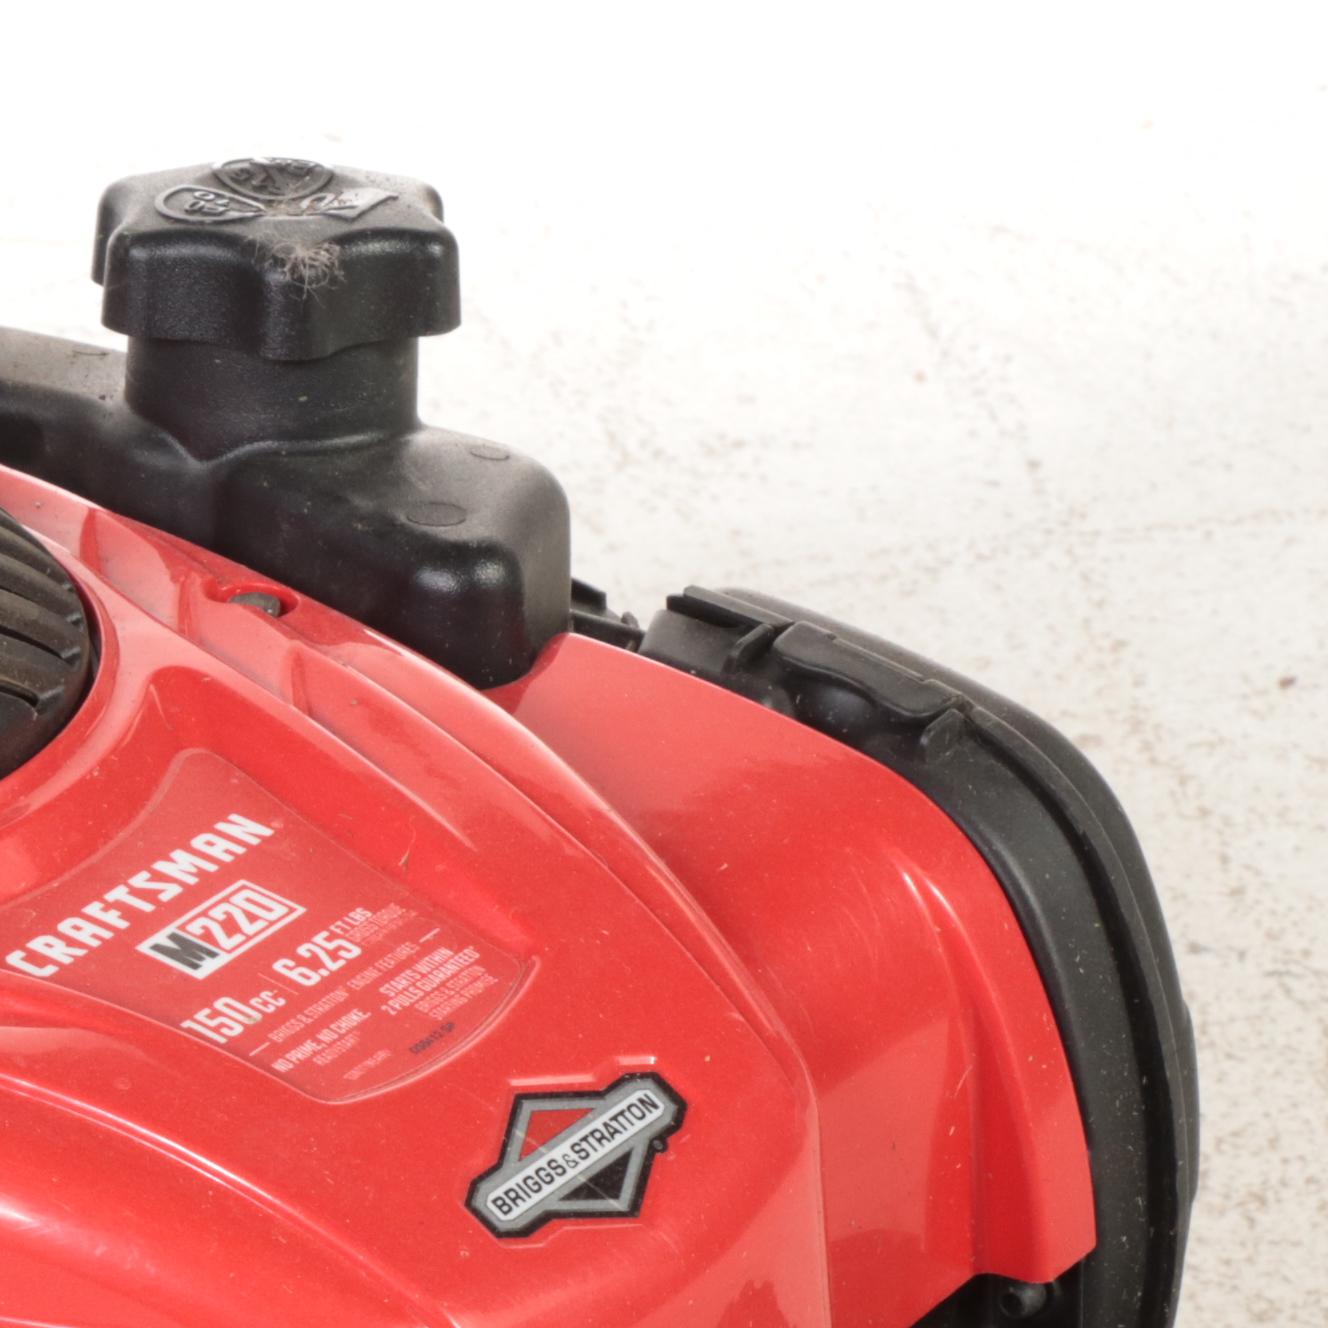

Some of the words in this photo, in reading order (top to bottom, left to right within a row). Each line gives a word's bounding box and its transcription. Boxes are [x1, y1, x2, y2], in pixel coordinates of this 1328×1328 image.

[5, 813, 274, 978] CRAFTSMAN
[149, 889, 290, 971] M220
[329, 919, 352, 935] FT
[272, 931, 362, 987] 6.25
